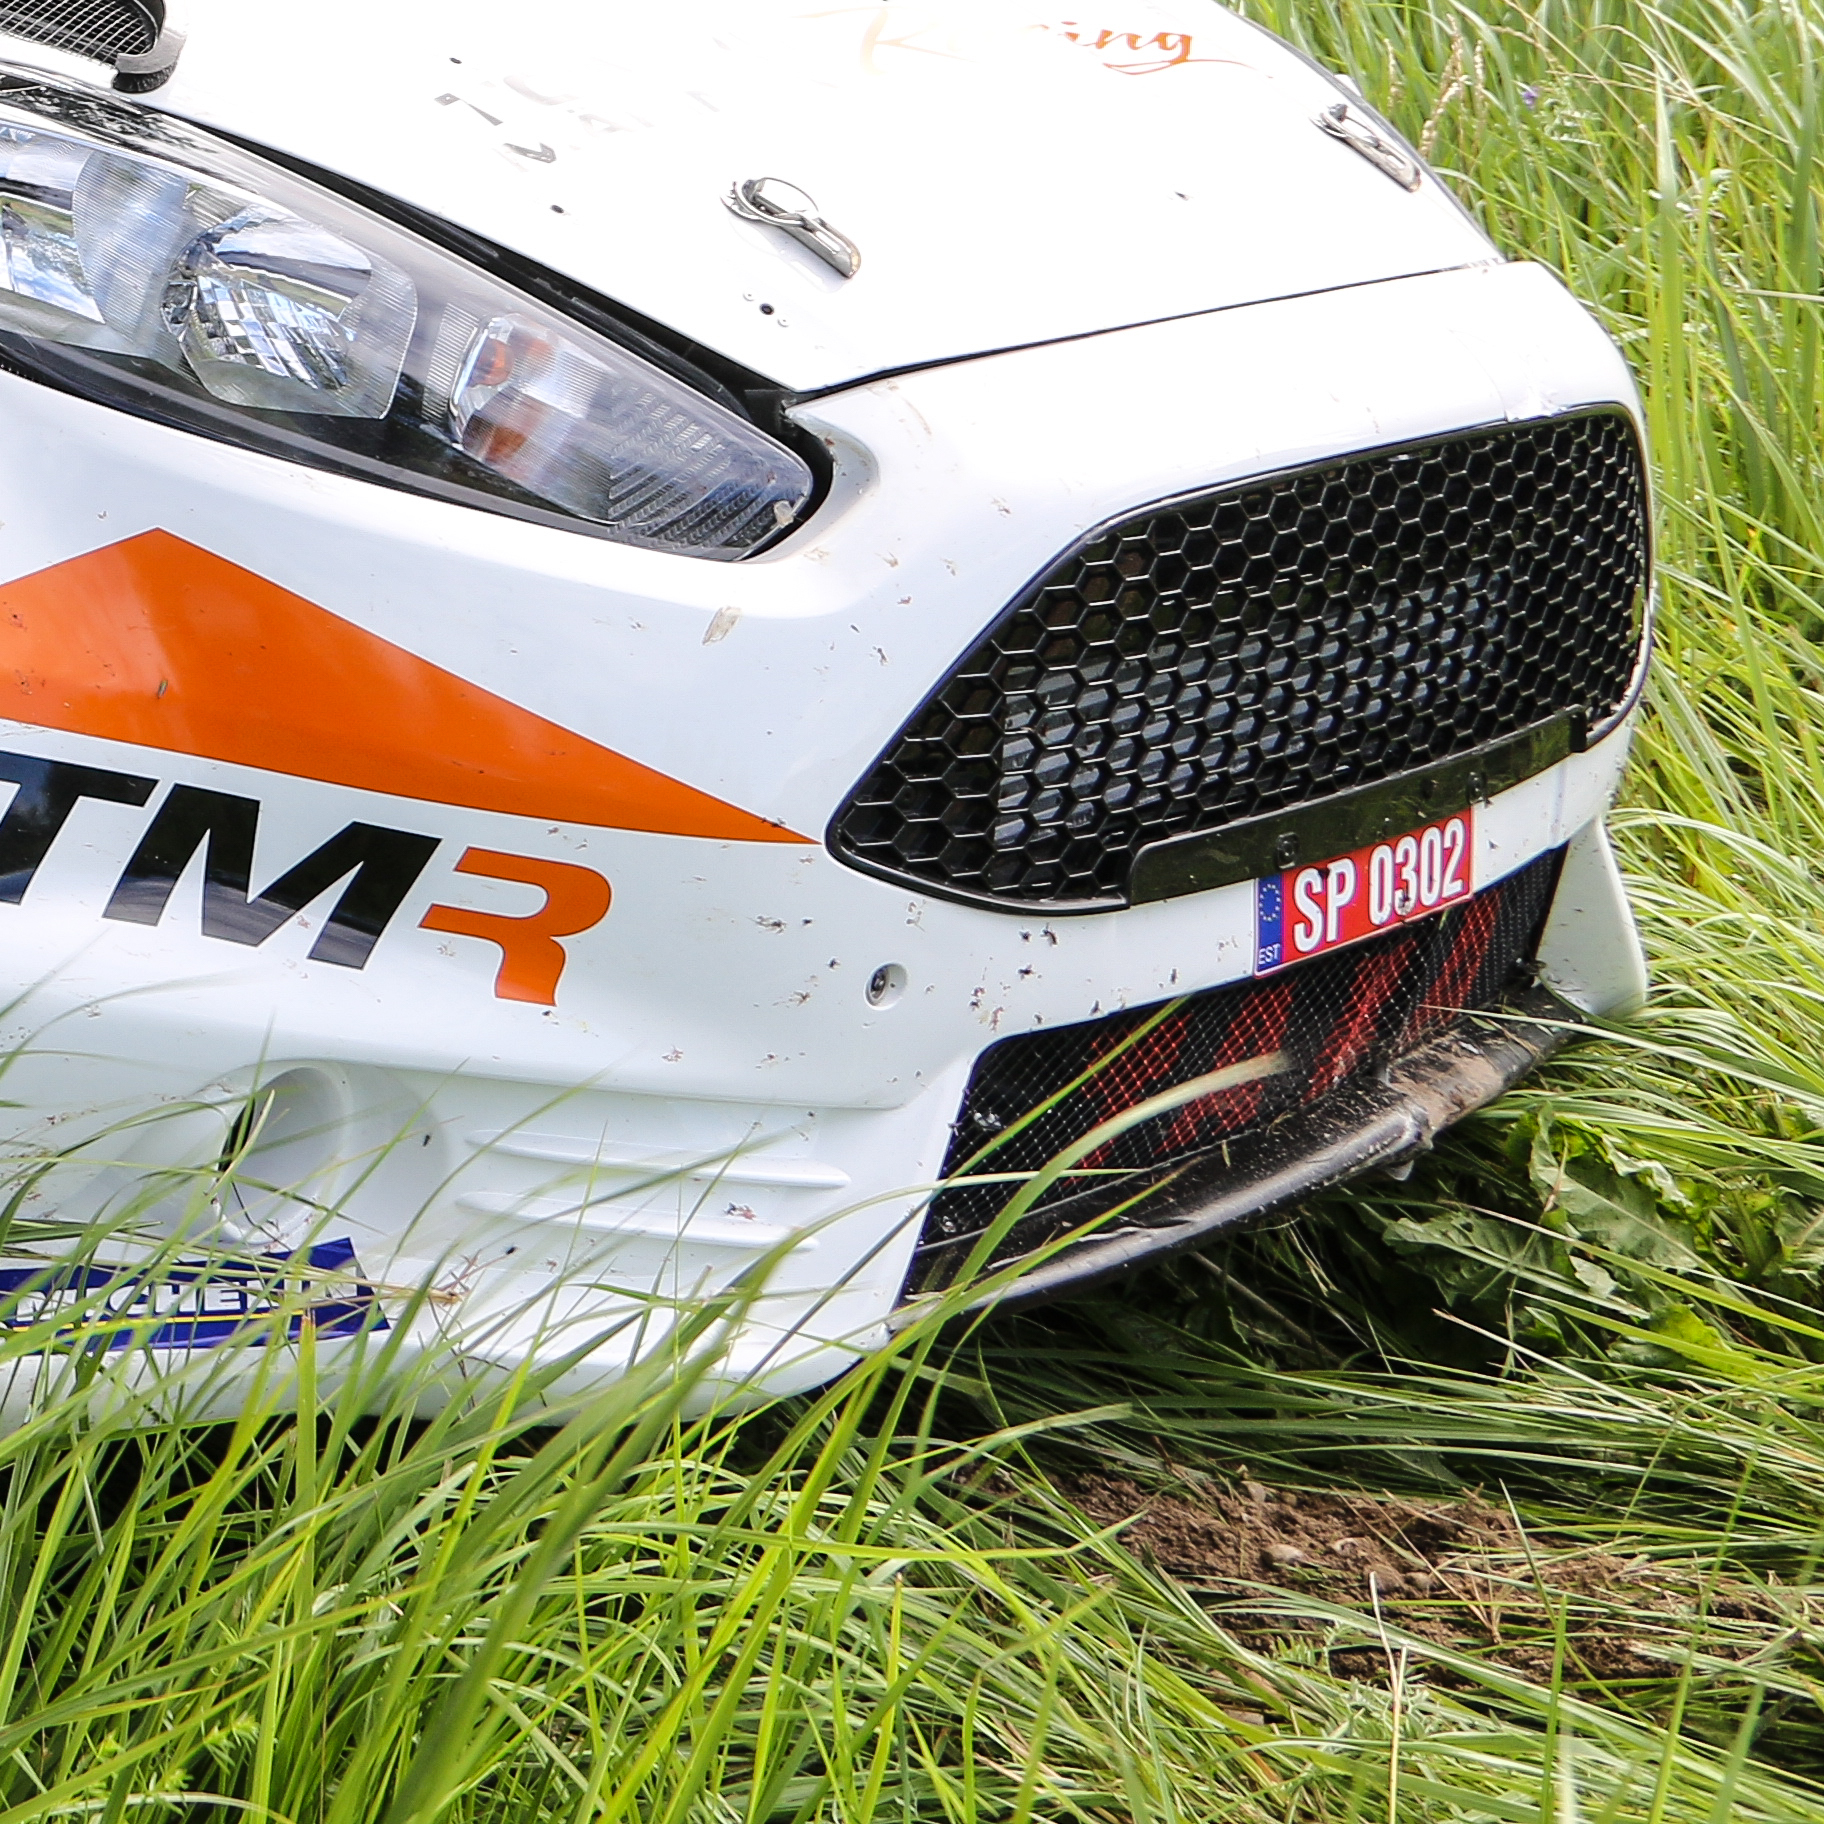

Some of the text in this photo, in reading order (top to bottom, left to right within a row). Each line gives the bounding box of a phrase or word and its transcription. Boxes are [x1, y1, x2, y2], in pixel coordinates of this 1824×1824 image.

[1292, 817, 1465, 953] SP 0302
[1258, 942, 1281, 966] EST
